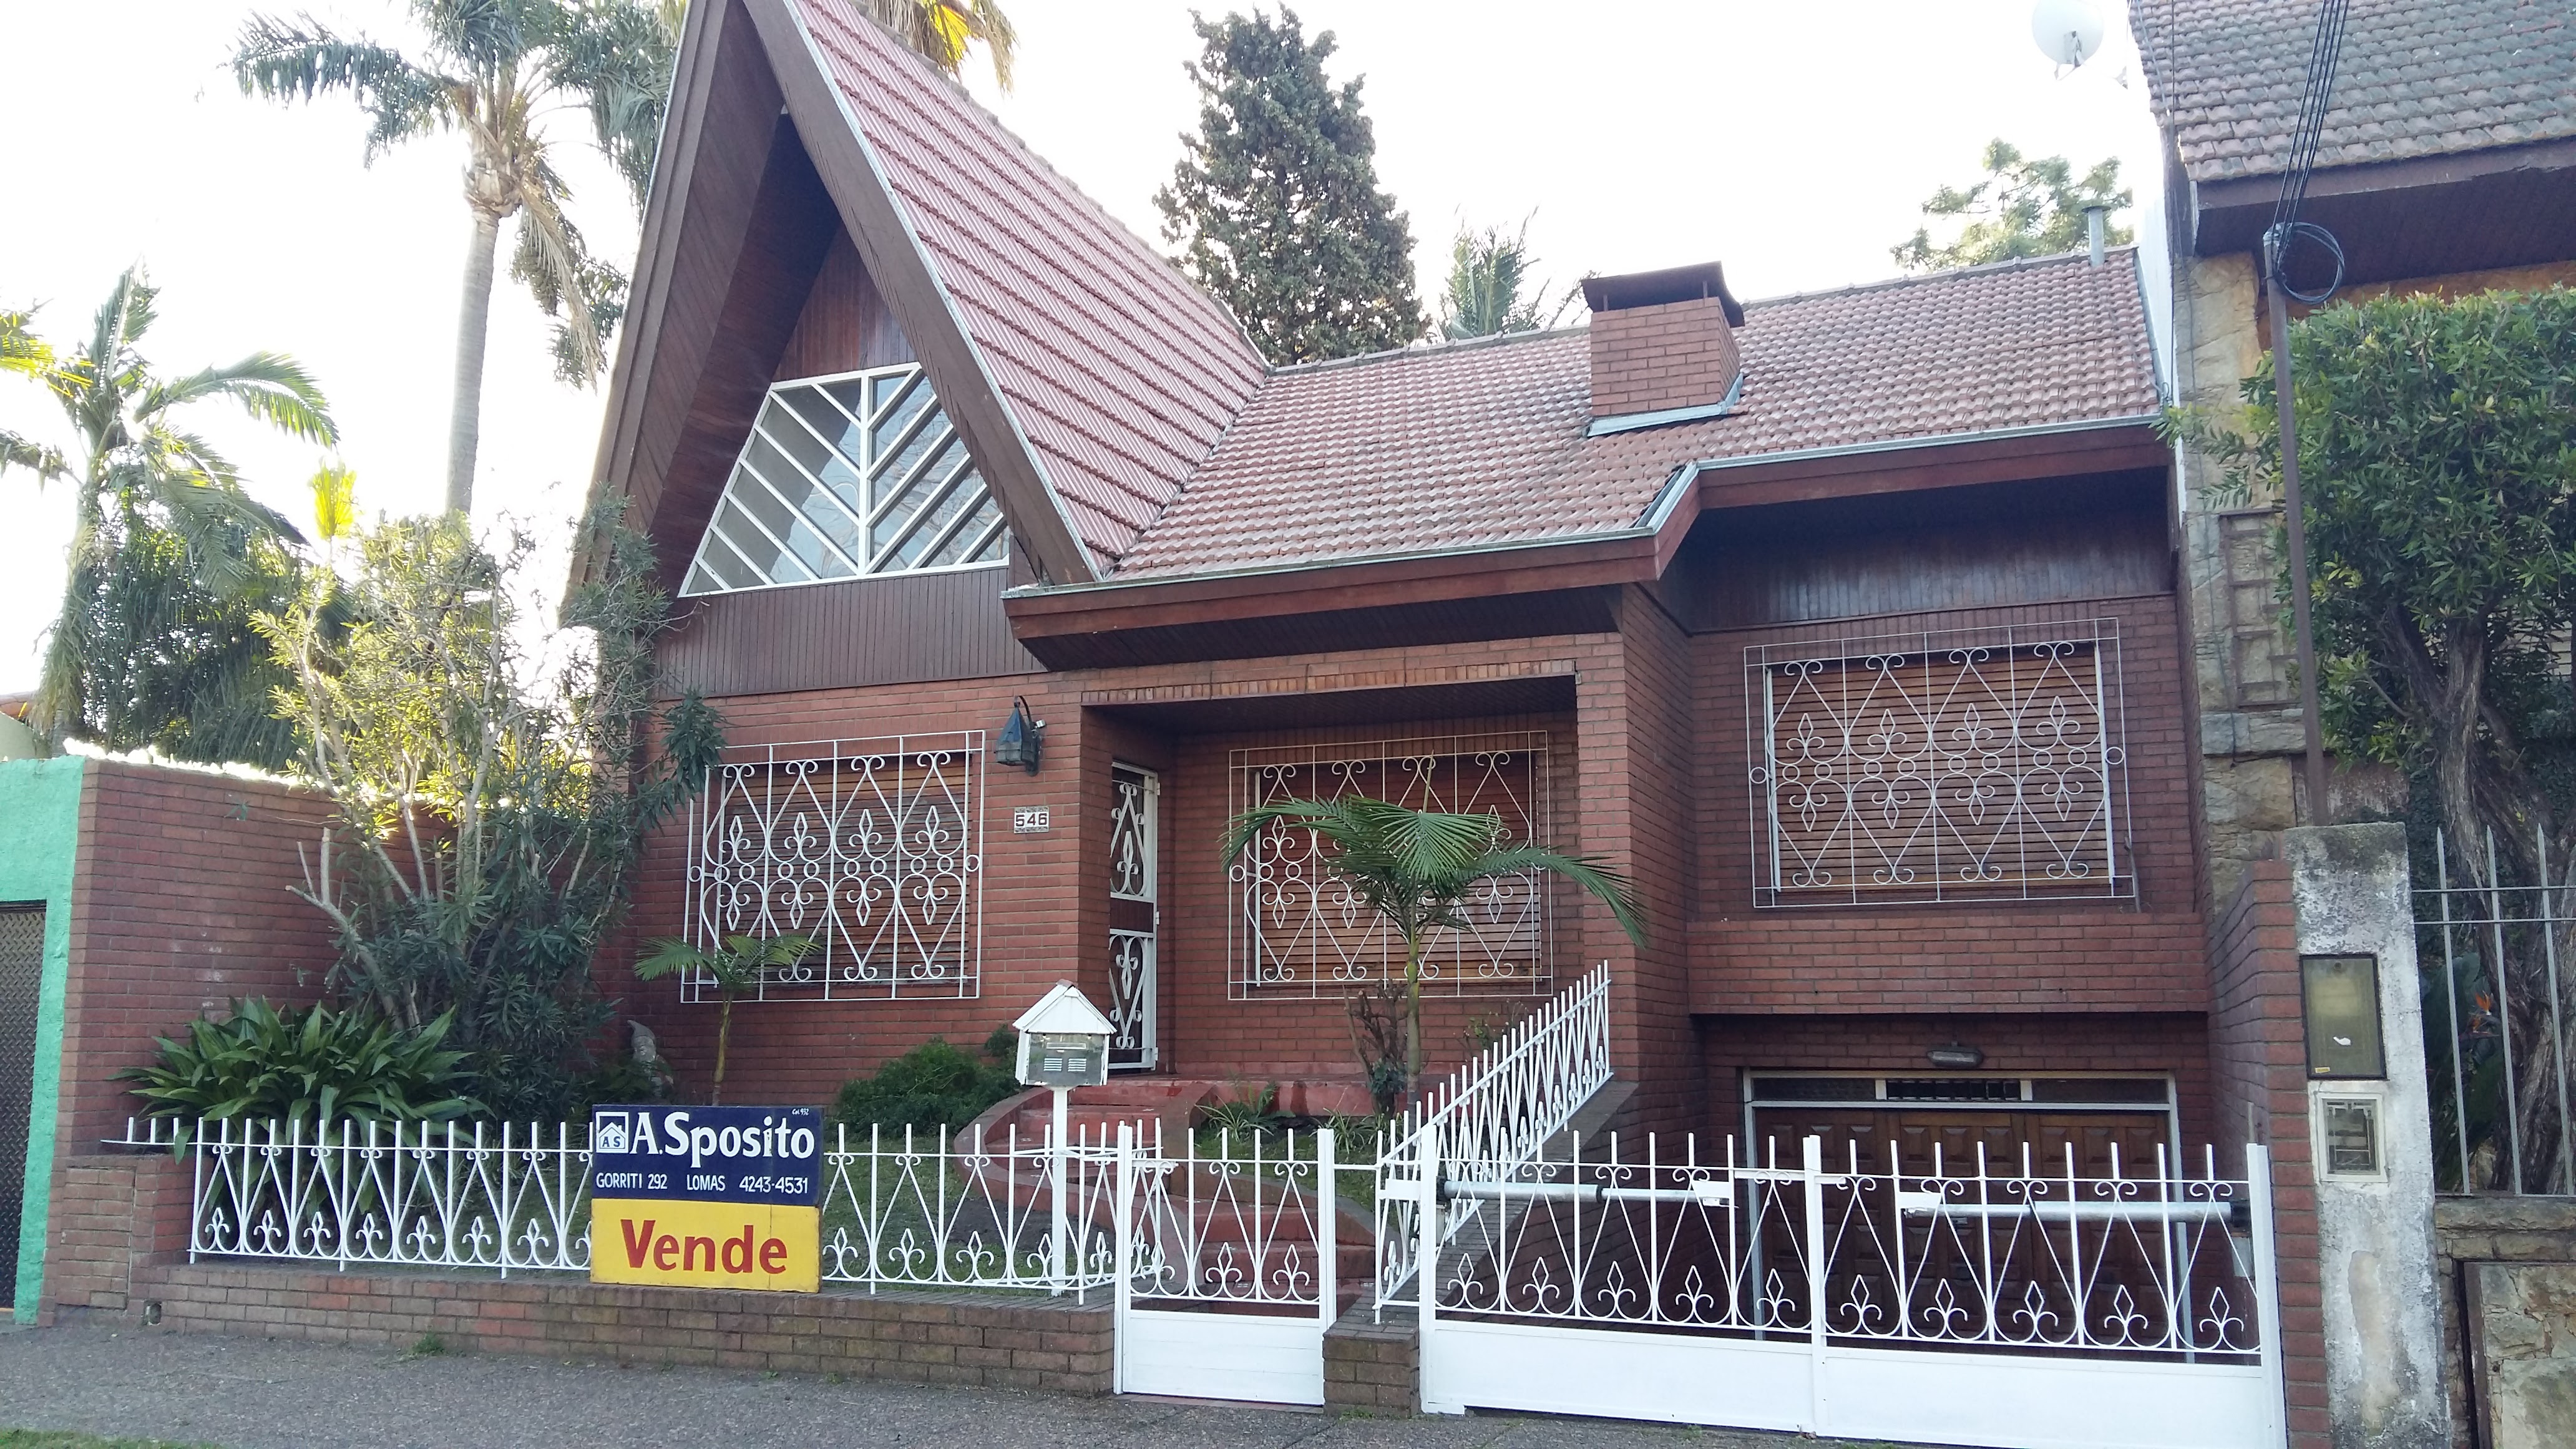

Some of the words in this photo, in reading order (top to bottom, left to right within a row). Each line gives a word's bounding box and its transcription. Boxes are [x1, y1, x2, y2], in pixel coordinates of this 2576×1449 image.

[1015, 812, 1047, 827] 546
[630, 1111, 814, 1168] A.Sposito
[596, 1173, 642, 1189] GORRITI
[648, 1173, 668, 1189] 292
[687, 1174, 726, 1191] LOMAS
[739, 1176, 808, 1194] 4243-4531
[620, 1219, 788, 1274] Vende
